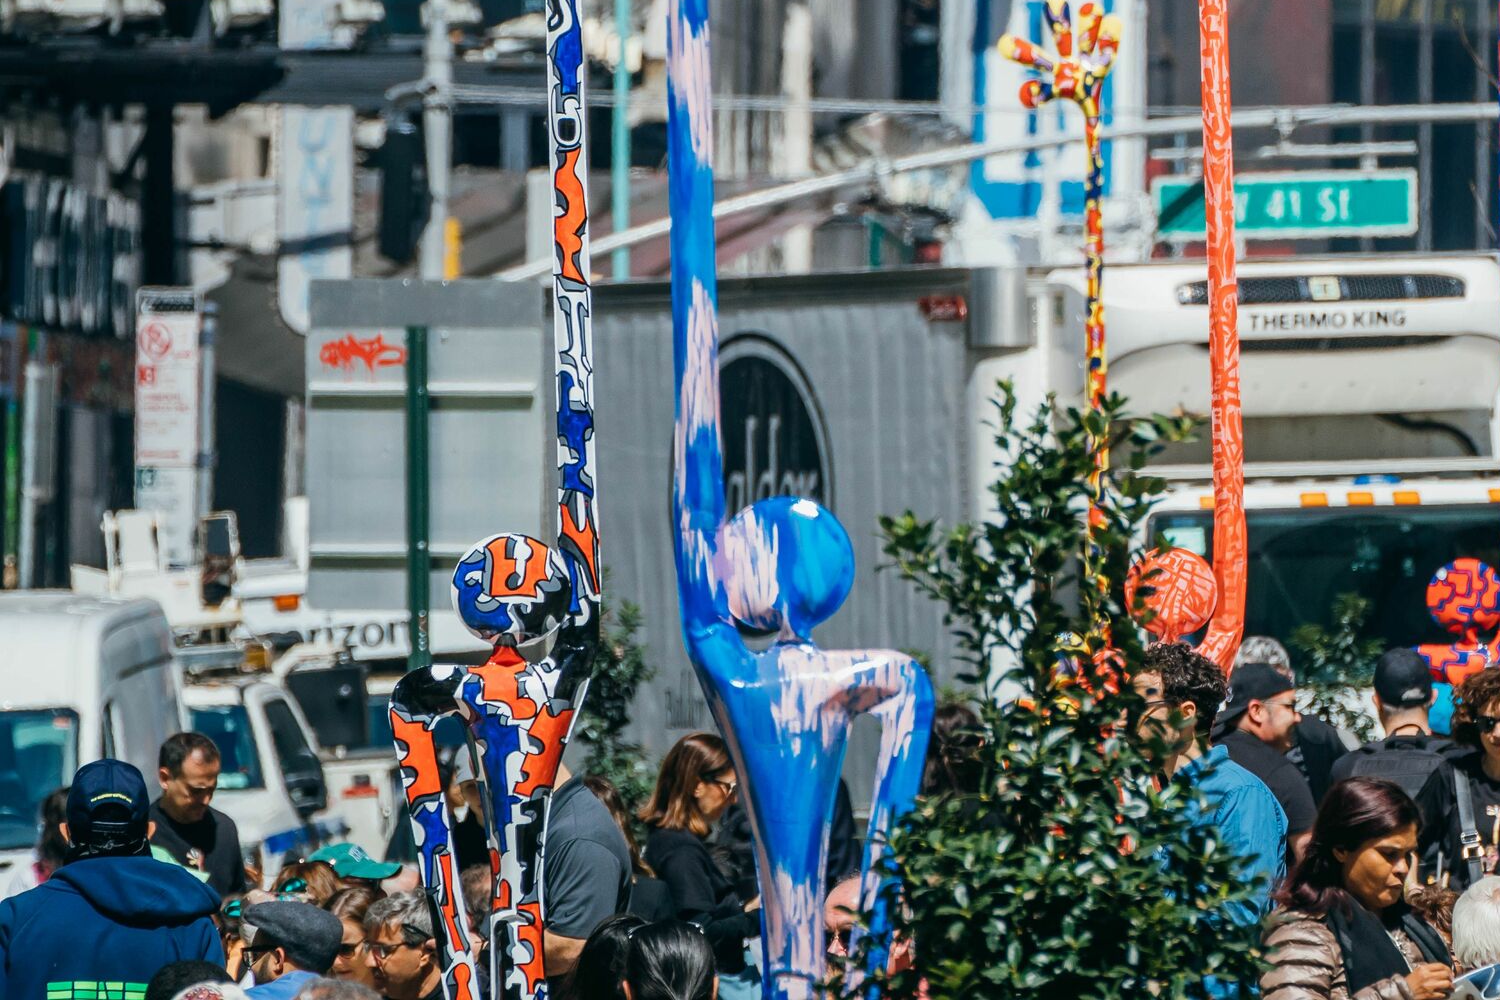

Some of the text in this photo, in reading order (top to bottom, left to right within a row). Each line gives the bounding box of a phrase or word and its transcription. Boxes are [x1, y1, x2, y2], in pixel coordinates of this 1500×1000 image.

[1266, 189, 1301, 221] 41
[1249, 310, 1407, 331] THERMO KING
